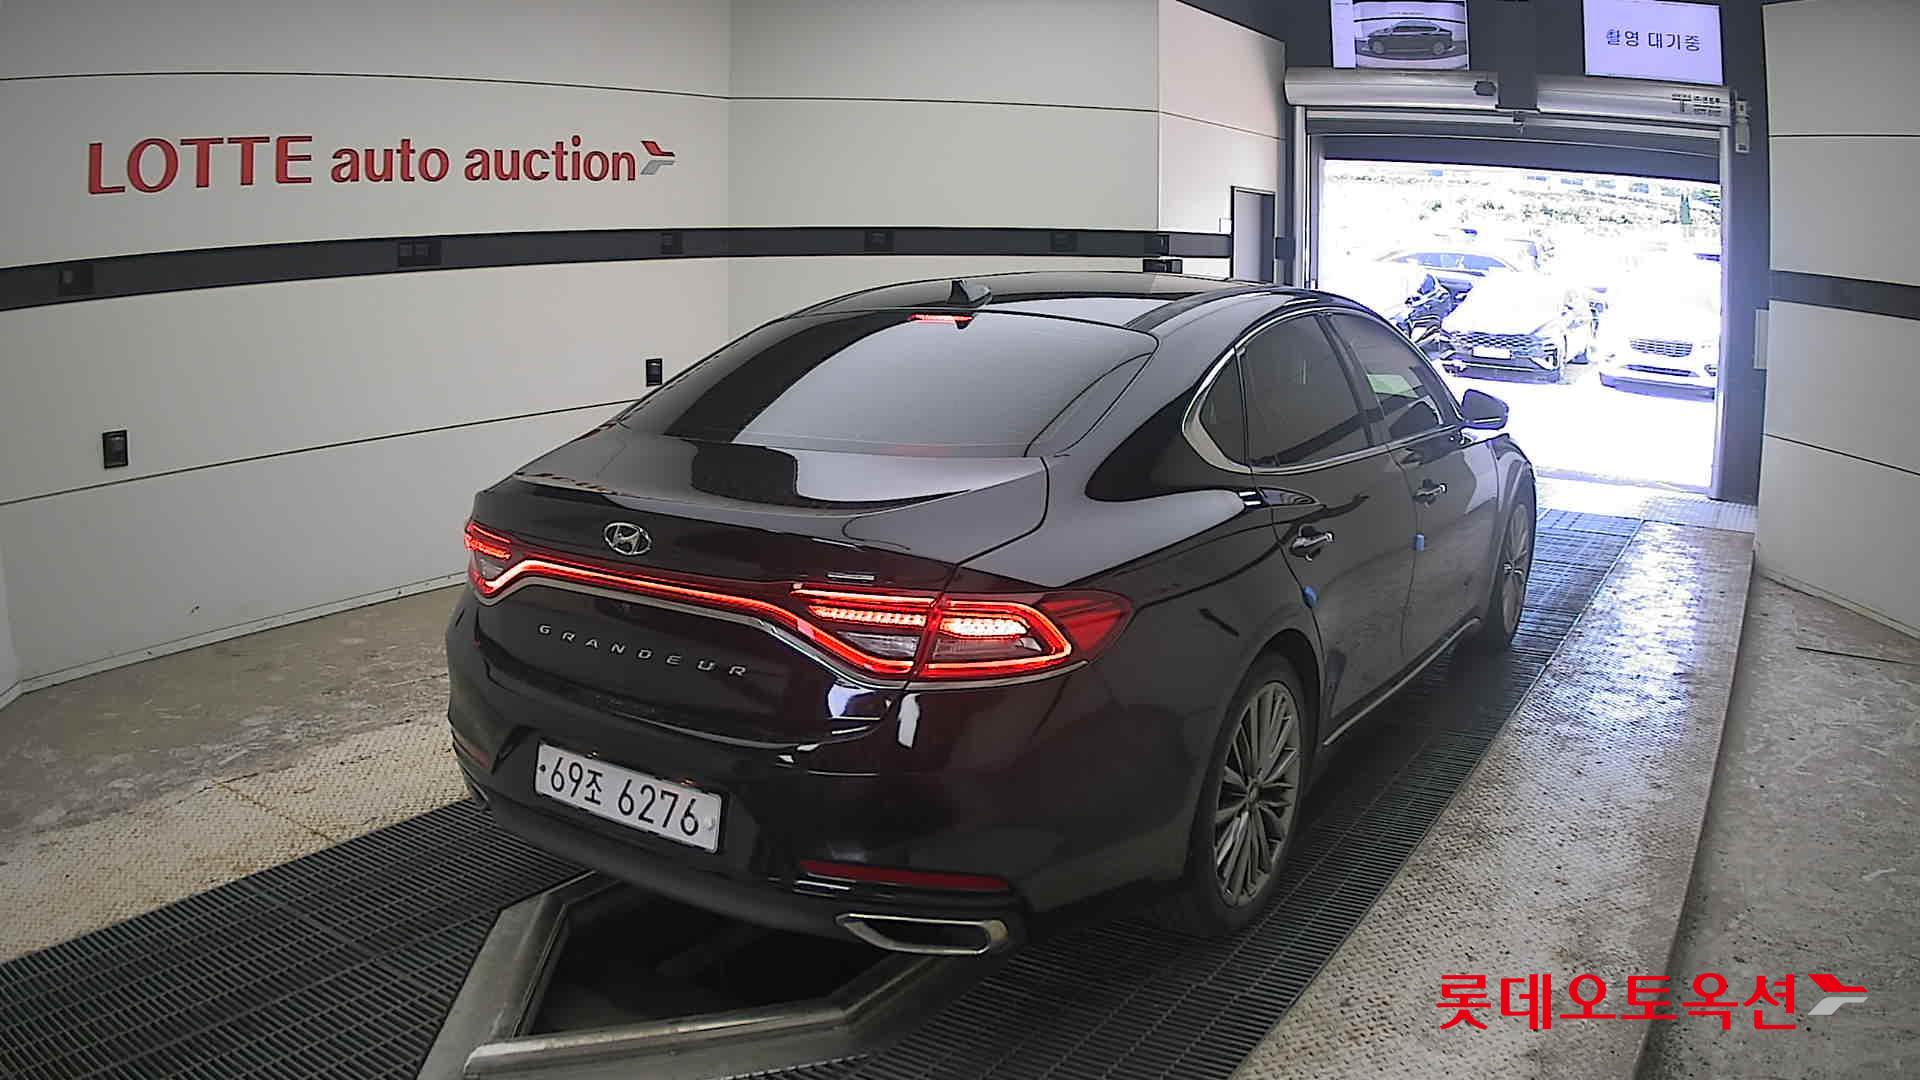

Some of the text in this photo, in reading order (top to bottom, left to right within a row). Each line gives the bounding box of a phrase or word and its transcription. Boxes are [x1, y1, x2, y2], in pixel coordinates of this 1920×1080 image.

[1648, 32, 1701, 52] 대기중
[88, 135, 637, 195] LOTTE auto auction
[538, 624, 747, 676] GRANDEUR
[550, 756, 699, 836] 69조 6276
